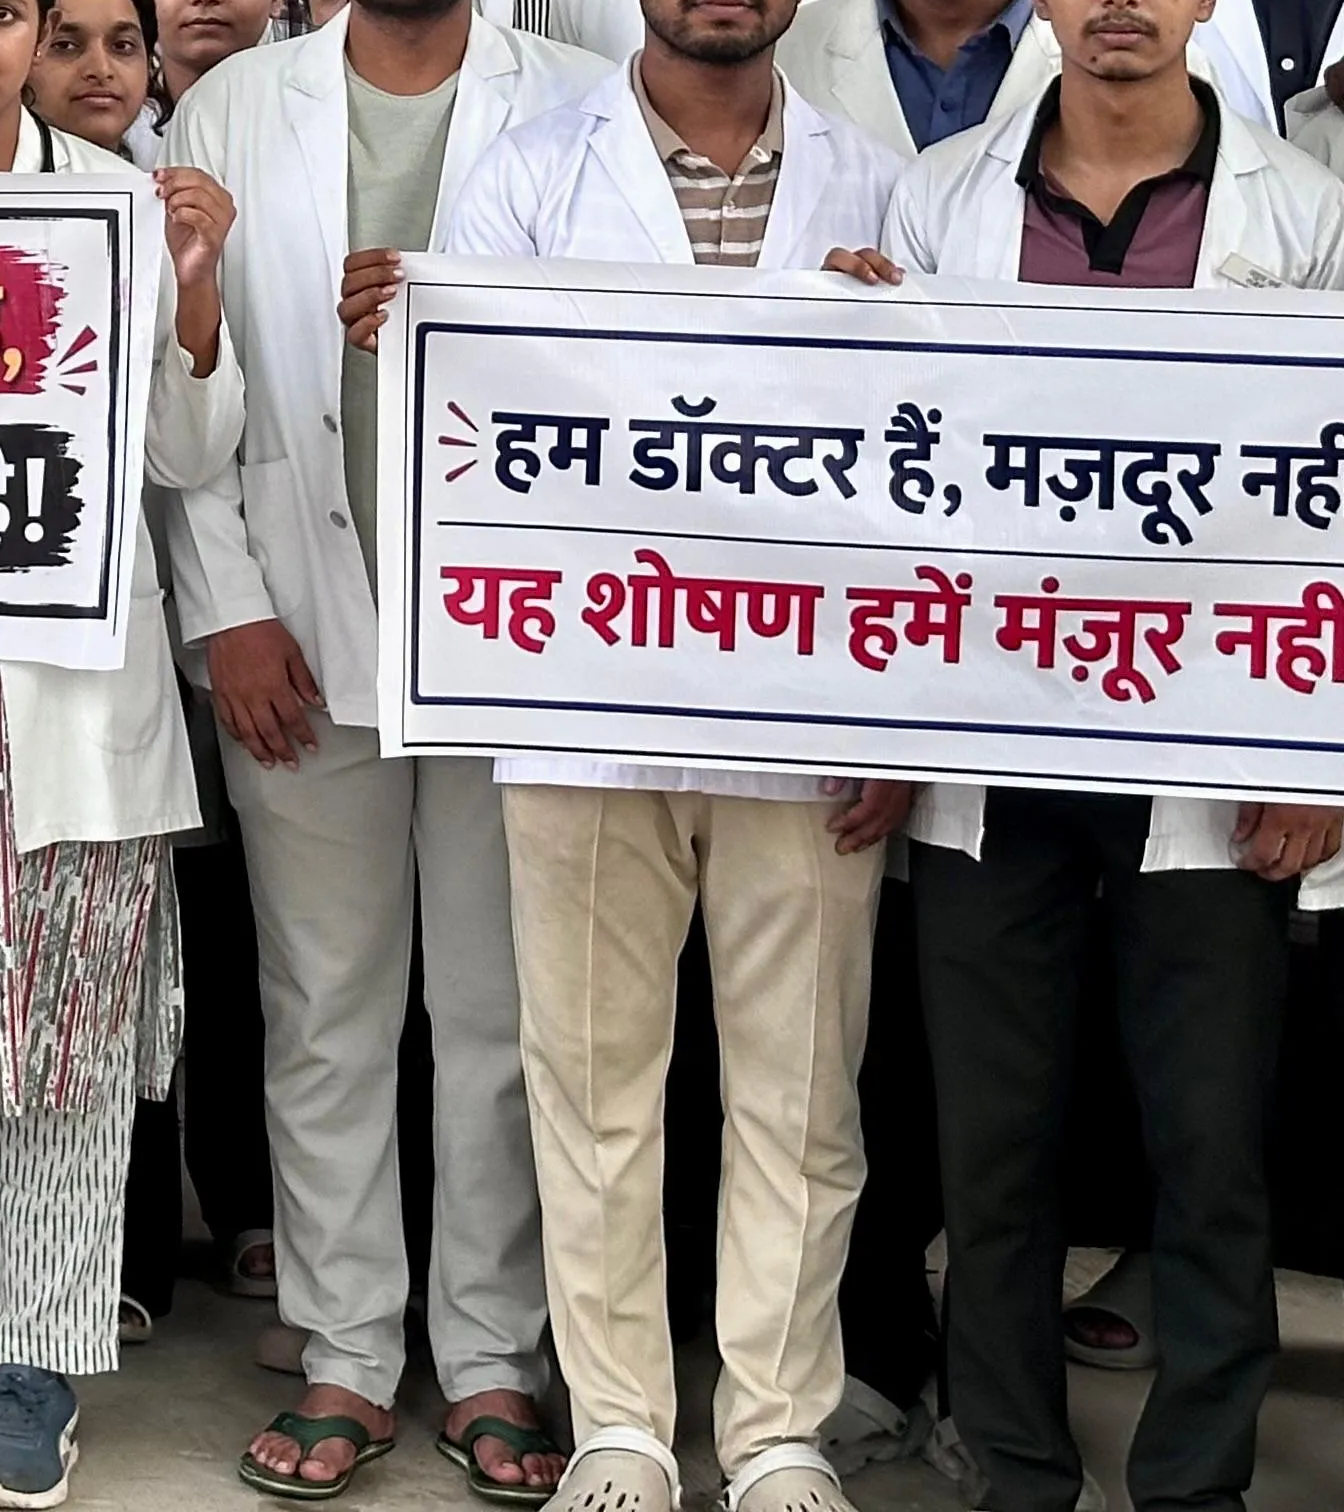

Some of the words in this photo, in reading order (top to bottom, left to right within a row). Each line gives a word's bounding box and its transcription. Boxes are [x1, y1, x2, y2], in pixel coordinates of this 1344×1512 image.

[490, 410, 611, 495] हम
[627, 394, 866, 501] डॉक्टर
[883, 401, 963, 518] हैं,
[981, 432, 1223, 547] मज़दूर
[440, 565, 562, 654] यह
[580, 549, 824, 655] शोषण
[846, 565, 971, 671] हमें
[995, 578, 1191, 702] मंज़ूर
